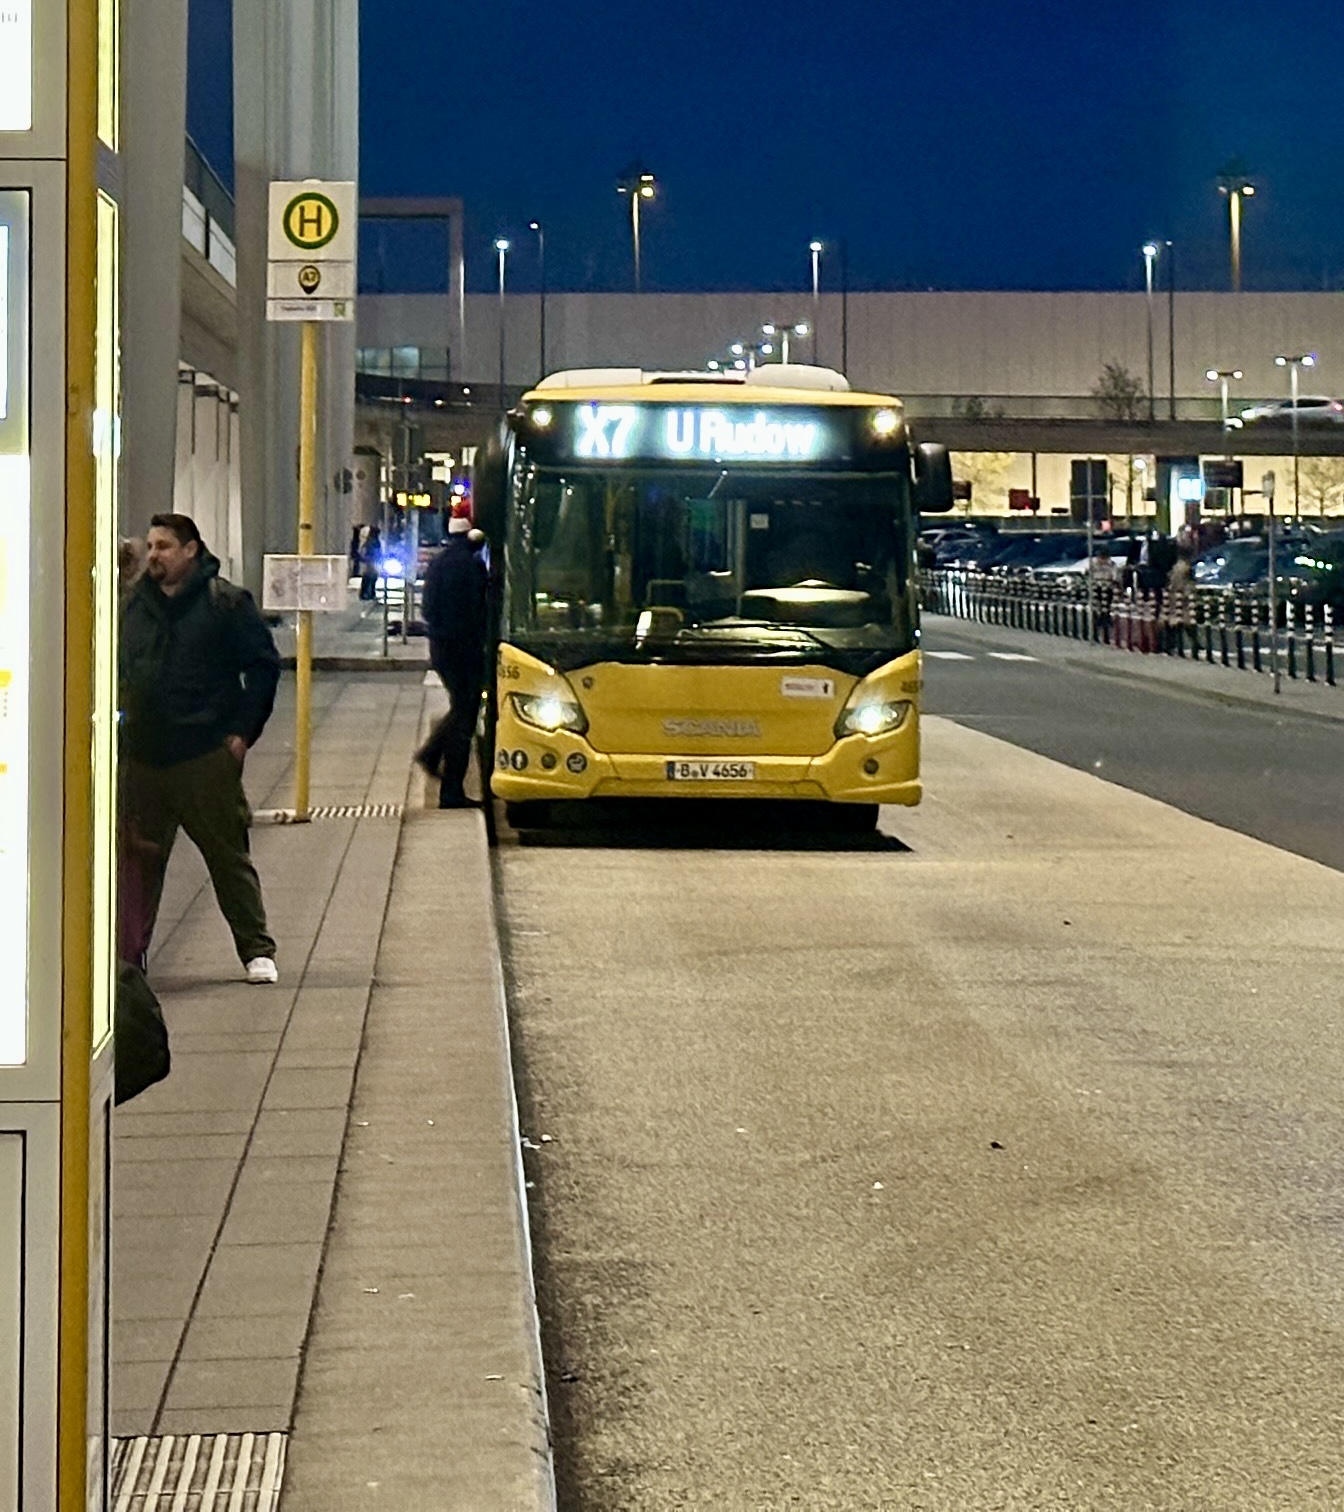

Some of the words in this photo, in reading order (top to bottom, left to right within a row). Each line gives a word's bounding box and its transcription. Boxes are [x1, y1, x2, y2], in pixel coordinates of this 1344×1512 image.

[298, 204, 323, 238] H
[578, 405, 637, 457] X7
[699, 411, 816, 455] Rudow
[662, 718, 761, 737] SCANIA
[712, 763, 748, 778] 4656
